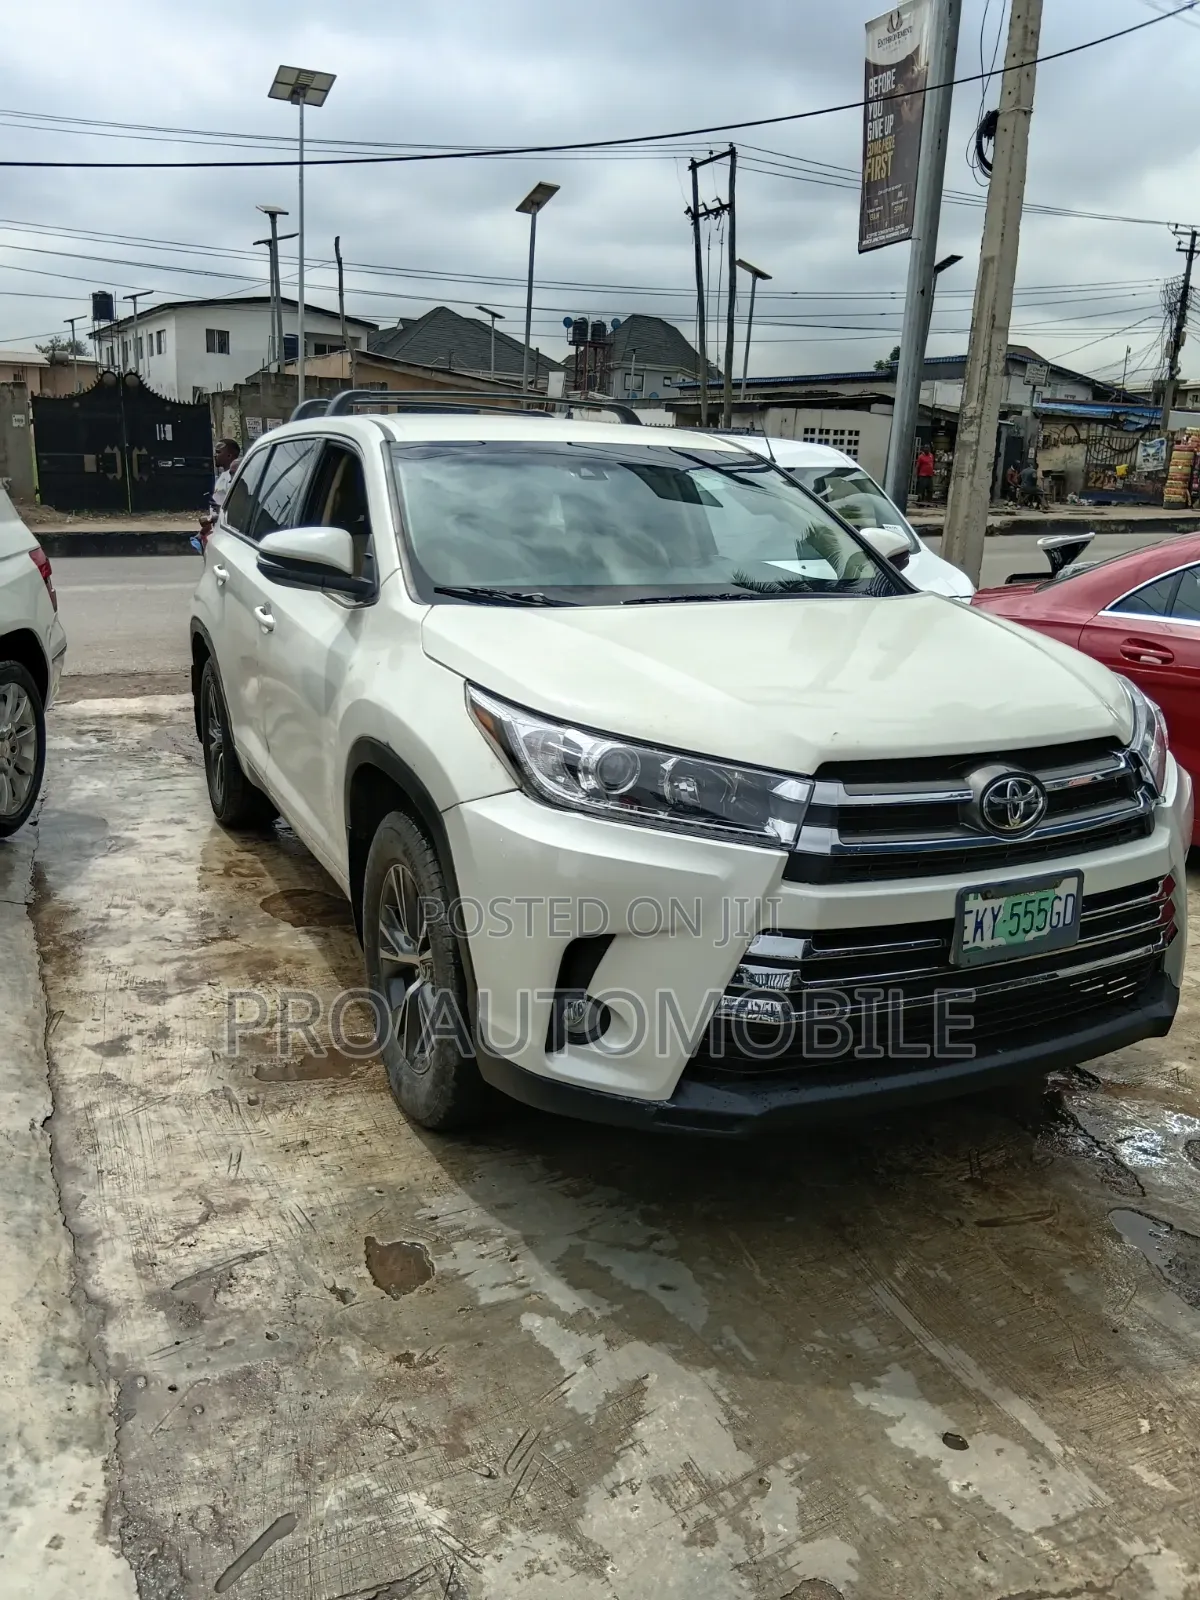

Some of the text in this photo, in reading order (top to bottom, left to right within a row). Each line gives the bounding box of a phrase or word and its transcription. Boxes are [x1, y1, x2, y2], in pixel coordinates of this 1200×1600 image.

[868, 68, 896, 98] BEFORE
[868, 96, 884, 120] YOU
[867, 114, 894, 142] GIVE UP
[864, 150, 894, 183] FIRST
